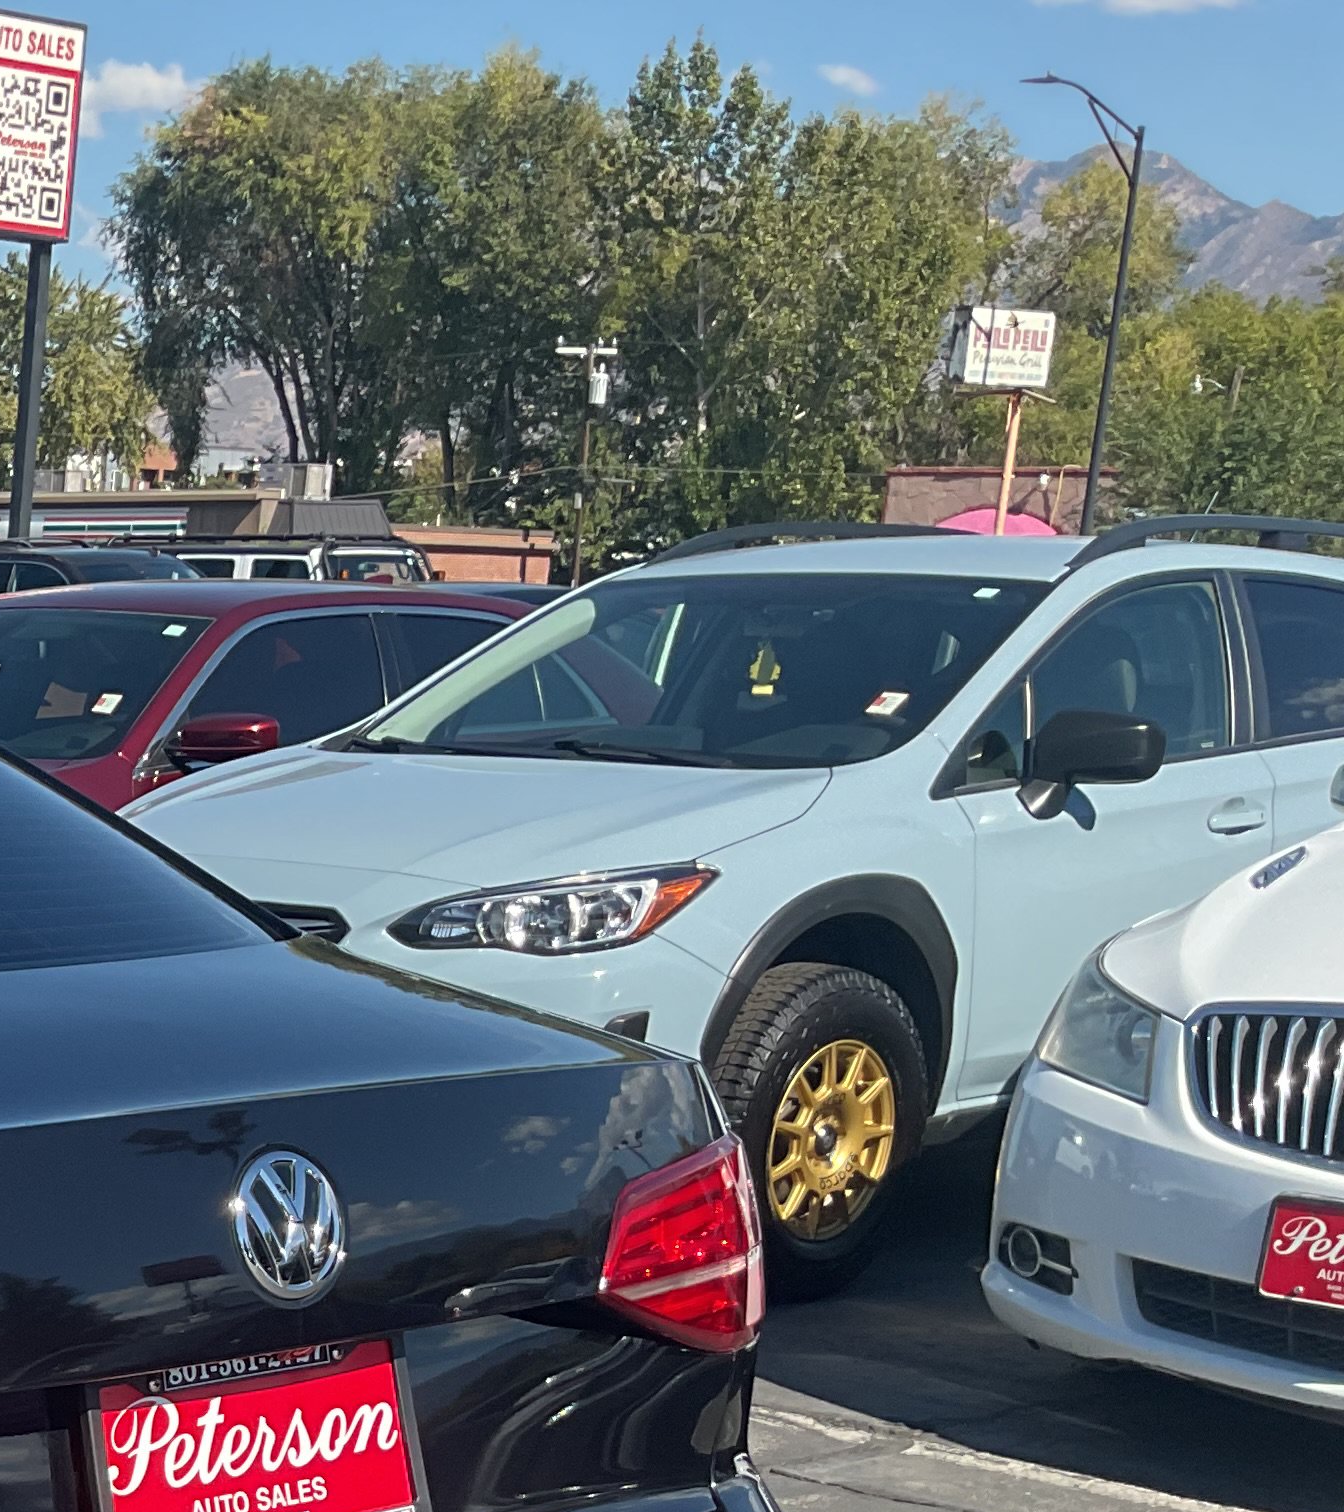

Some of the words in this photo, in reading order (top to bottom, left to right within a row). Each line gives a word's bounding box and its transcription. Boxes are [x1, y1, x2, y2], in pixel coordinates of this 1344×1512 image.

[27, 31, 75, 61] SALES
[1019, 352, 1042, 368] Grill
[107, 1396, 398, 1496] Peterson
[255, 1476, 328, 1511] SALES
